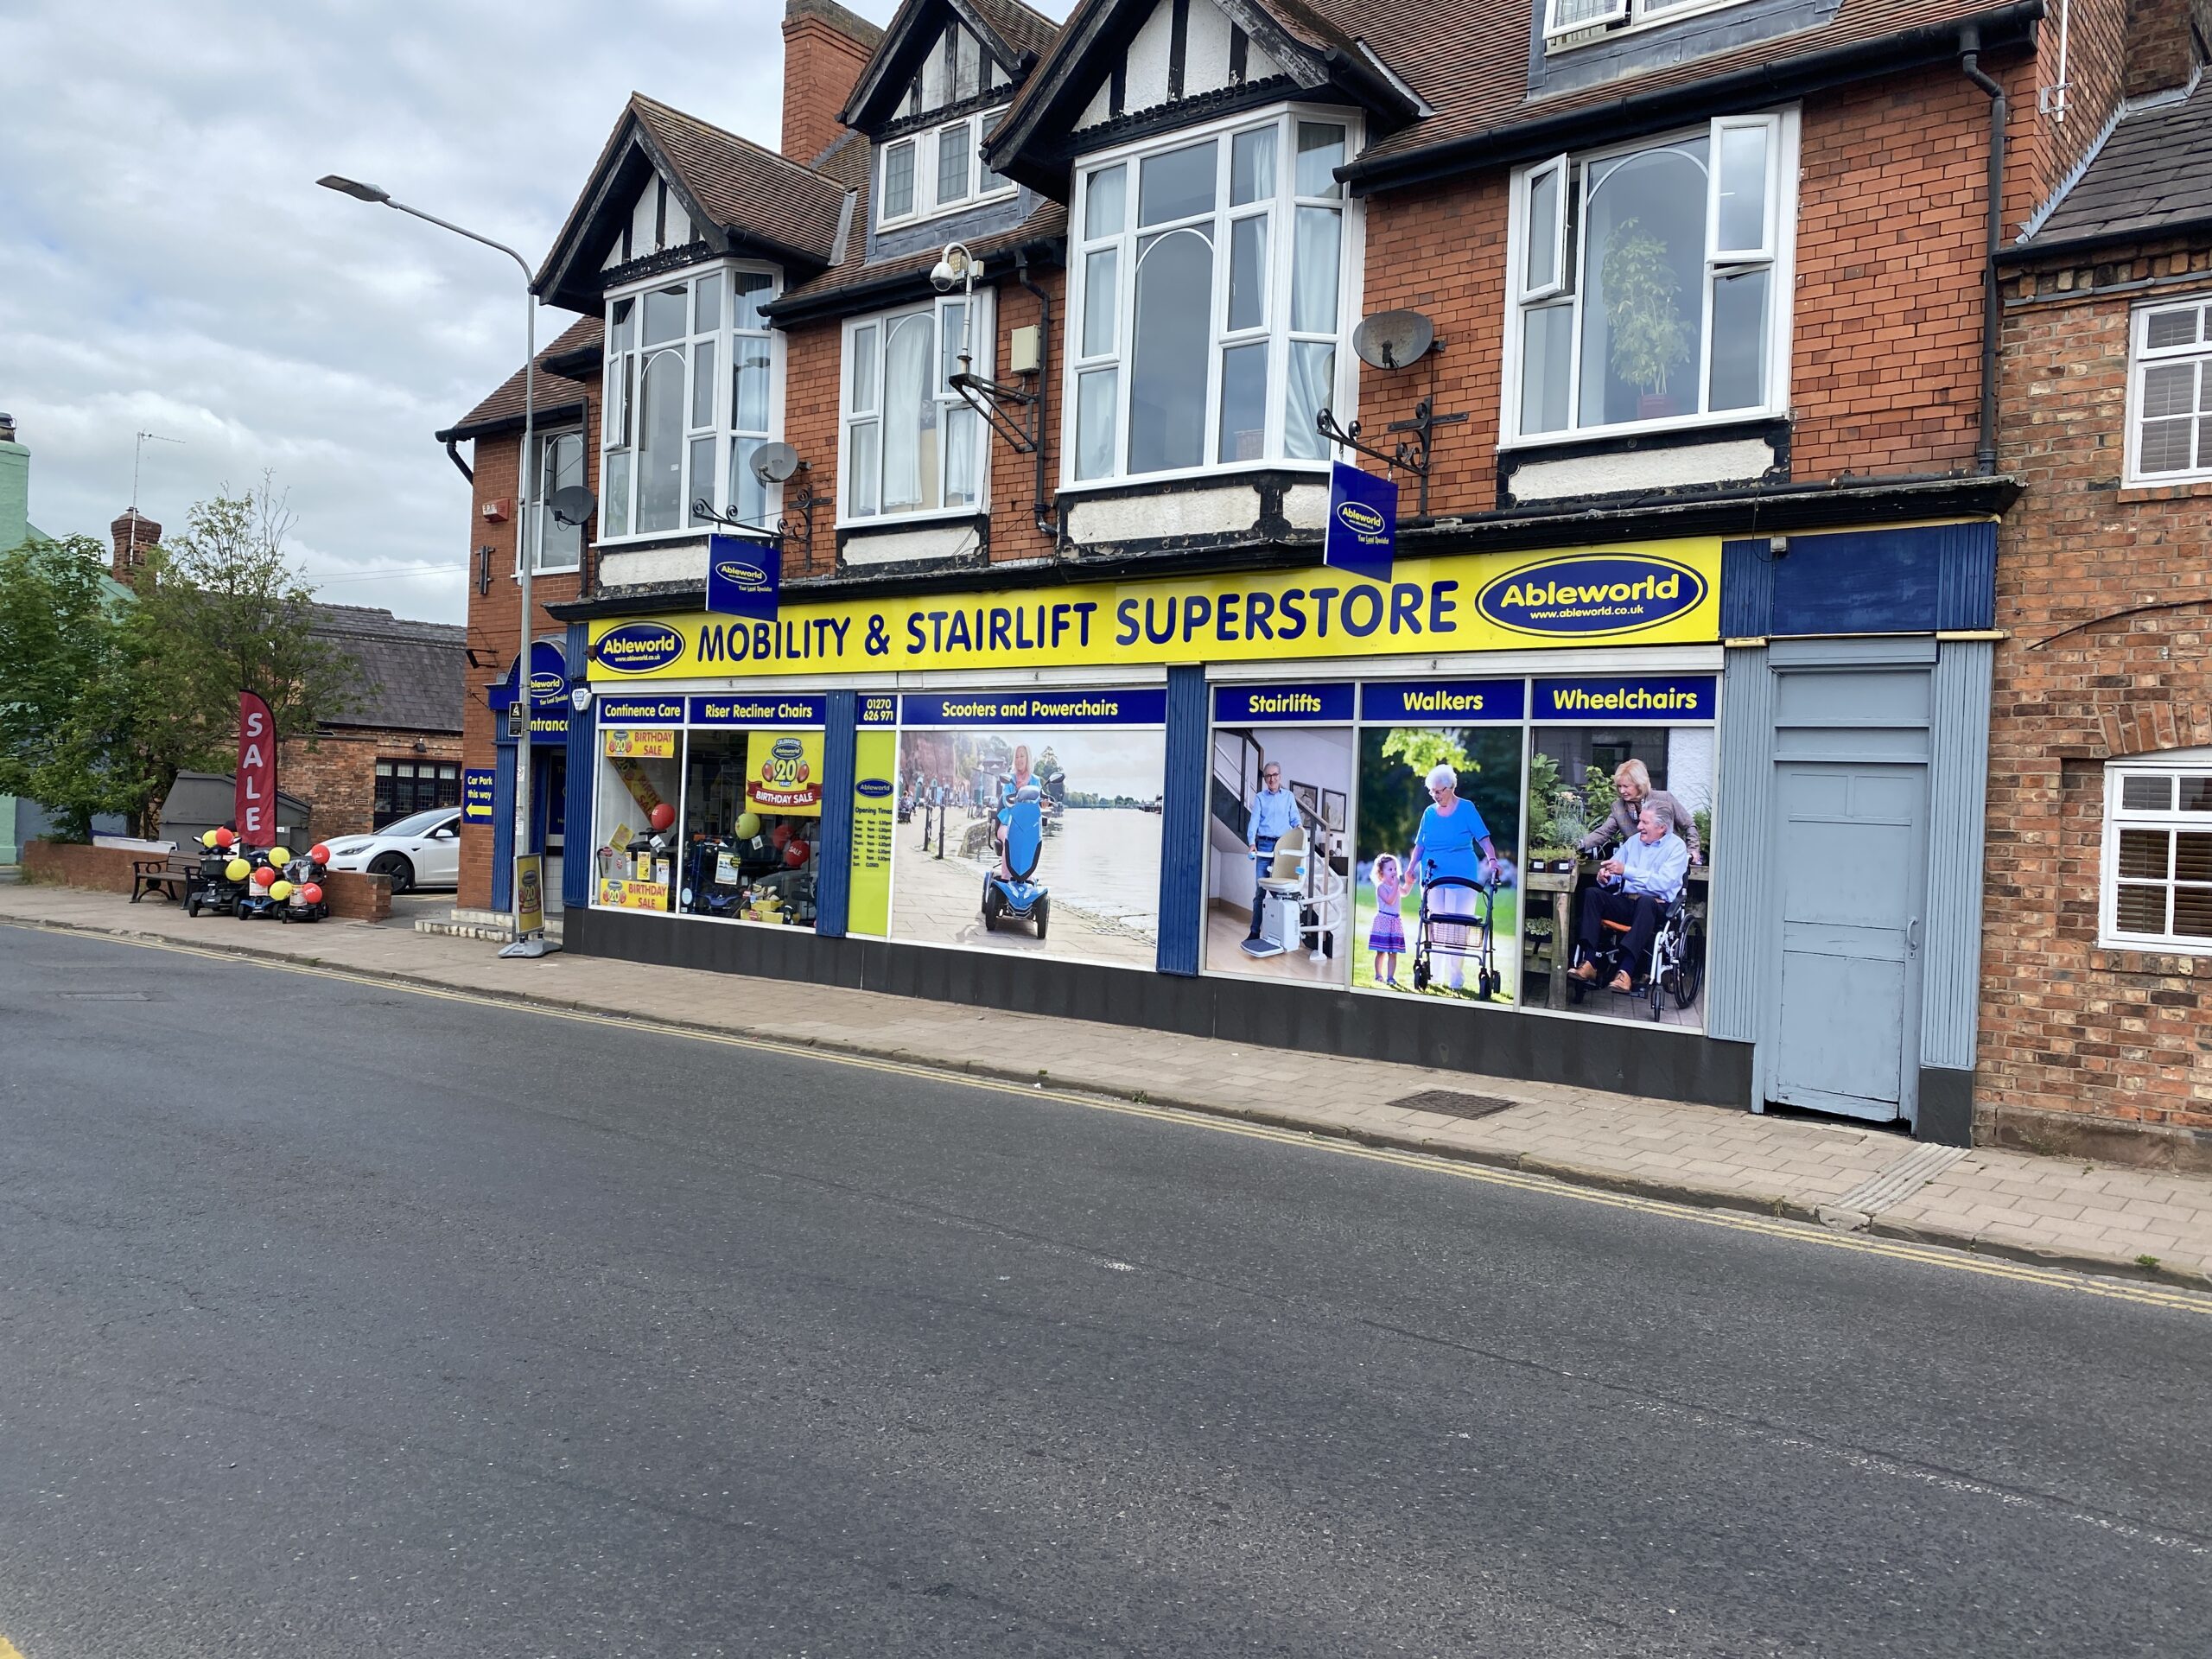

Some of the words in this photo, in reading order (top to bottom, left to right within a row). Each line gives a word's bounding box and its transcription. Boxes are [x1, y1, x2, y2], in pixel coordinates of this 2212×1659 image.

[1342, 506, 1381, 527] Ableworld
[721, 565, 762, 580] Ableworld
[1500, 573, 1680, 607] Ableworld
[1529, 605, 1643, 620] www.ableworld.co.uk
[697, 616, 851, 663] MOBILITY
[864, 614, 890, 656] &
[907, 601, 1097, 654] STAIRLIFT
[1116, 580, 1459, 646] SUPERSTORE
[603, 634, 675, 654] Ableworld
[614, 653, 661, 663] www.ableworld.co.uk
[531, 678, 560, 689] bleworld
[867, 699, 892, 709] 01270
[1249, 693, 1321, 713] Stairlifts
[1403, 690, 1484, 711] Walkers
[1553, 687, 1698, 709] Wheelchairs
[605, 703, 655, 717] Continence
[658, 703, 681, 717] Care
[705, 704, 730, 718] Riser
[733, 703, 775, 718] Recliner
[778, 702, 813, 718] Chairs
[942, 701, 996, 717] Scooters
[1000, 701, 1027, 717] and
[1031, 698, 1118, 716] Powerchairs
[863, 710, 879, 721] 626
[880, 710, 893, 721] 971
[531, 716, 569, 732] ntranc
[634, 732, 672, 743] BIRTHDAY
[615, 740, 626, 752] 20
[643, 745, 663, 755] SALE
[243, 713, 264, 831] SALE
[775, 759, 796, 781] 20
[467, 775, 479, 785] Car
[479, 775, 493, 785] Park
[467, 789, 479, 798] this
[479, 791, 492, 802] way
[755, 791, 792, 804] BIRTHDAY
[793, 792, 813, 804] SALE
[789, 846, 802, 856] SALE
[524, 886, 536, 899] 20
[608, 890, 620, 902] 20
[628, 883, 666, 897] BIRTHDAY
[638, 897, 656, 909] SALE
